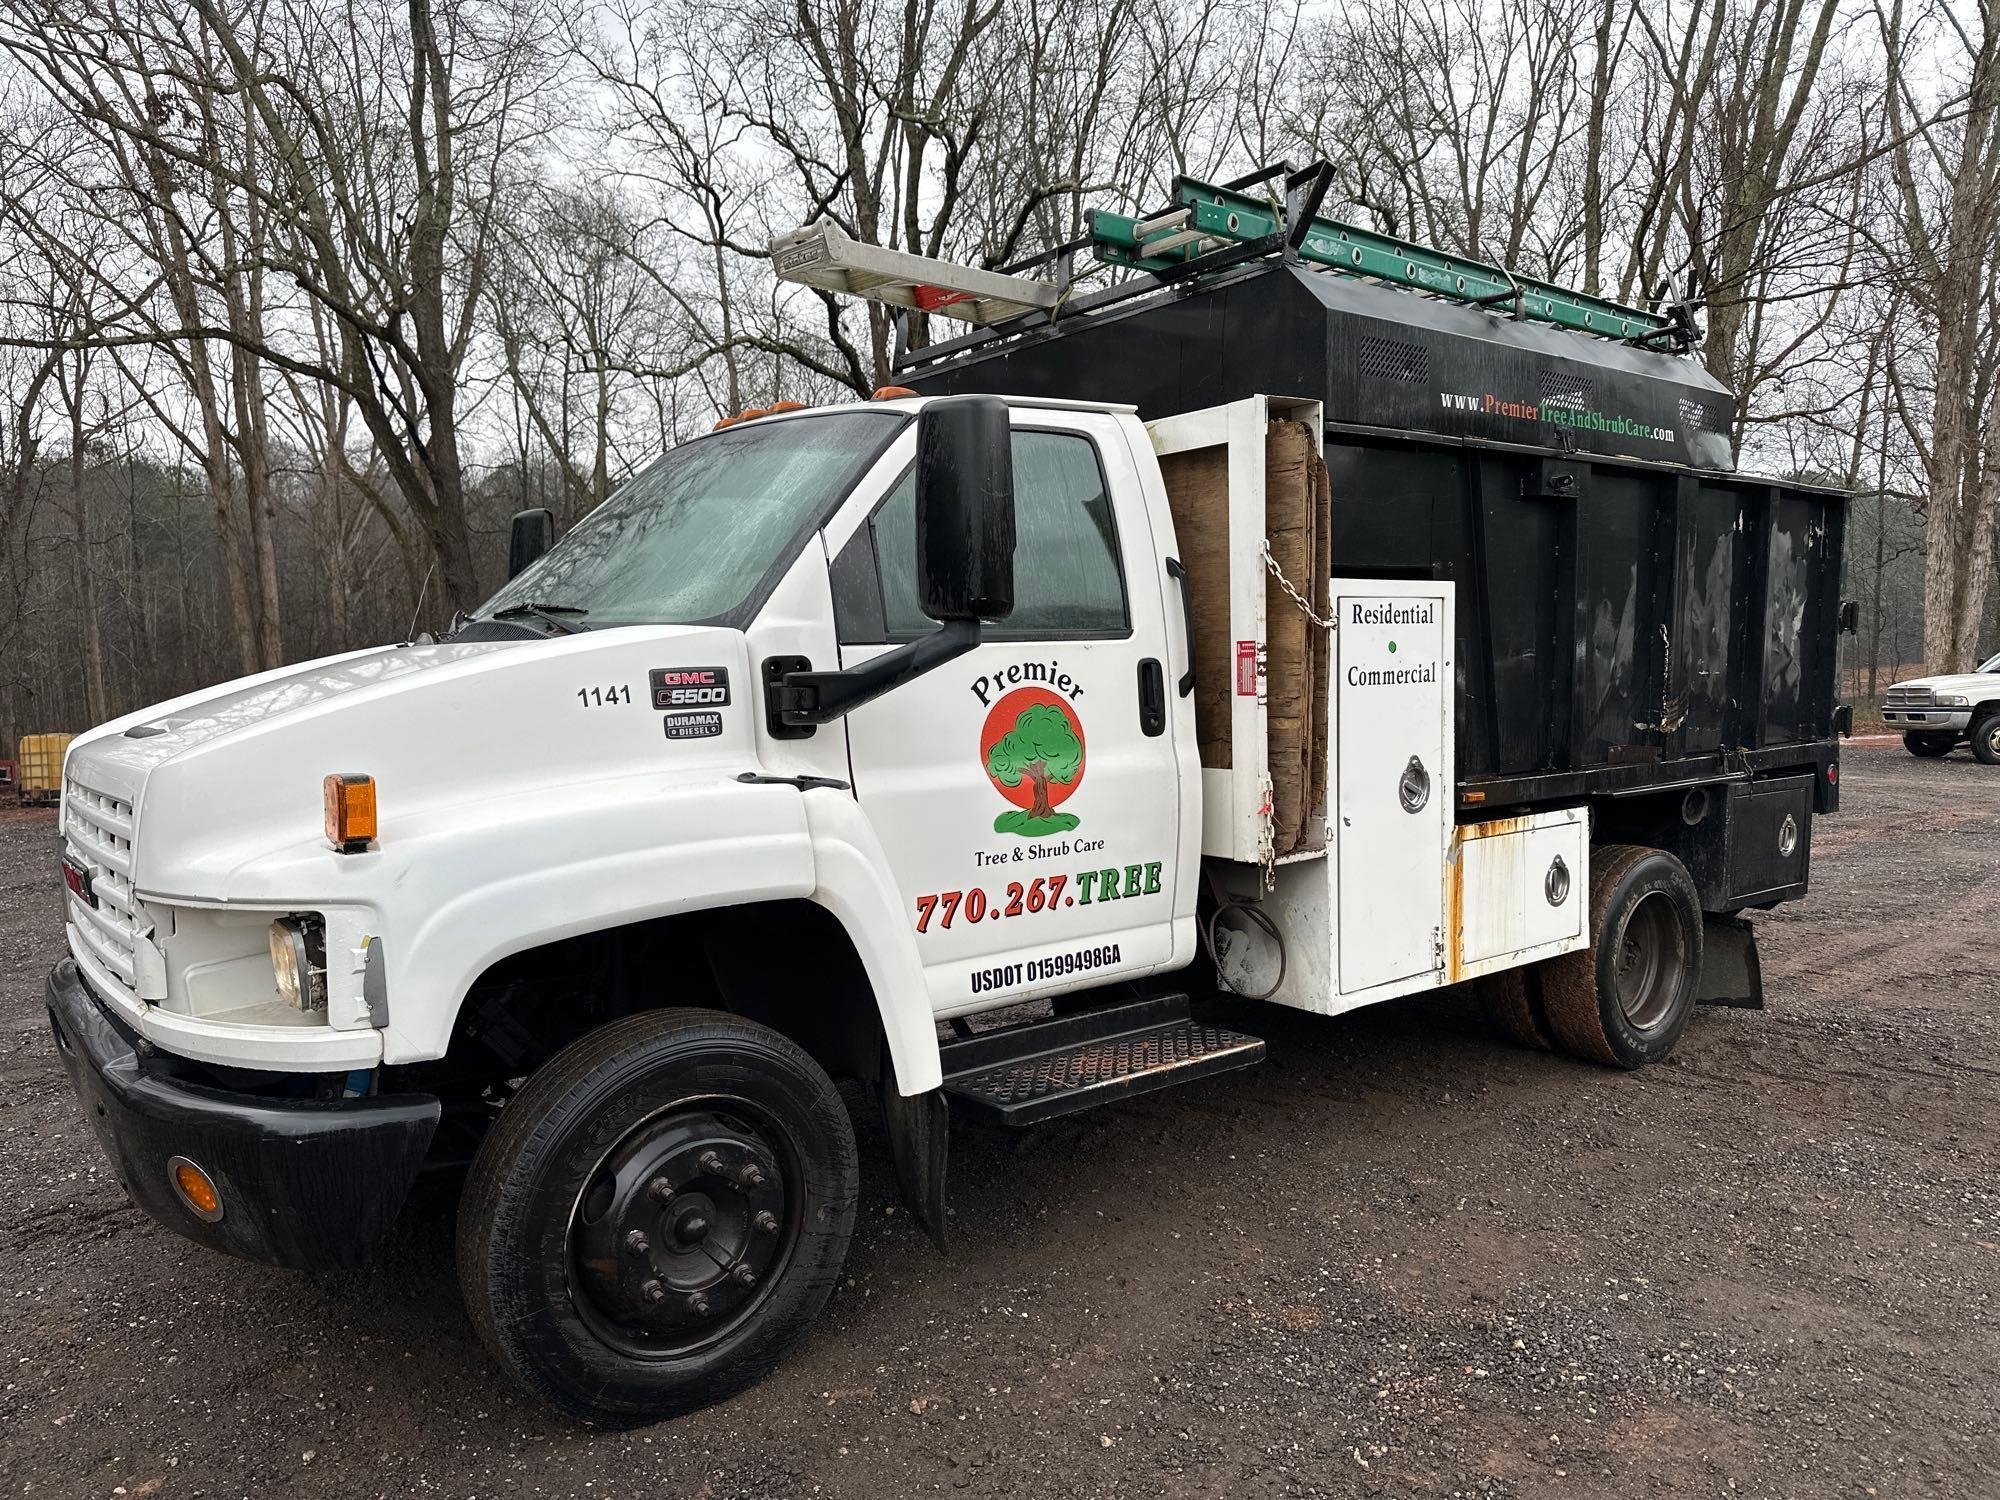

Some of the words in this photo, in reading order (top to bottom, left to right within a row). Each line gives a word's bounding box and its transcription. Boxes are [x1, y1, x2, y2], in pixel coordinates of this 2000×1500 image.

[1440, 391, 1675, 443] www.PremierTreeAndShrubCare.com
[1352, 602, 1434, 625] Residential
[664, 671, 716, 685] GMC
[970, 660, 1085, 708] Premier
[1348, 661, 1436, 687] Commercial
[577, 684, 632, 707] 1141
[656, 687, 726, 706] C5500
[666, 714, 720, 727] DURAMAX
[679, 726, 711, 736] DIESEL
[974, 850, 1008, 867] Tree
[1011, 846, 1024, 862] &
[1027, 841, 1070, 861] Shrub
[1073, 838, 1105, 853] Care
[916, 861, 1163, 934] 770.267.TREE
[970, 963, 1024, 994] USDOT
[1026, 943, 1122, 982] 01599498GA
